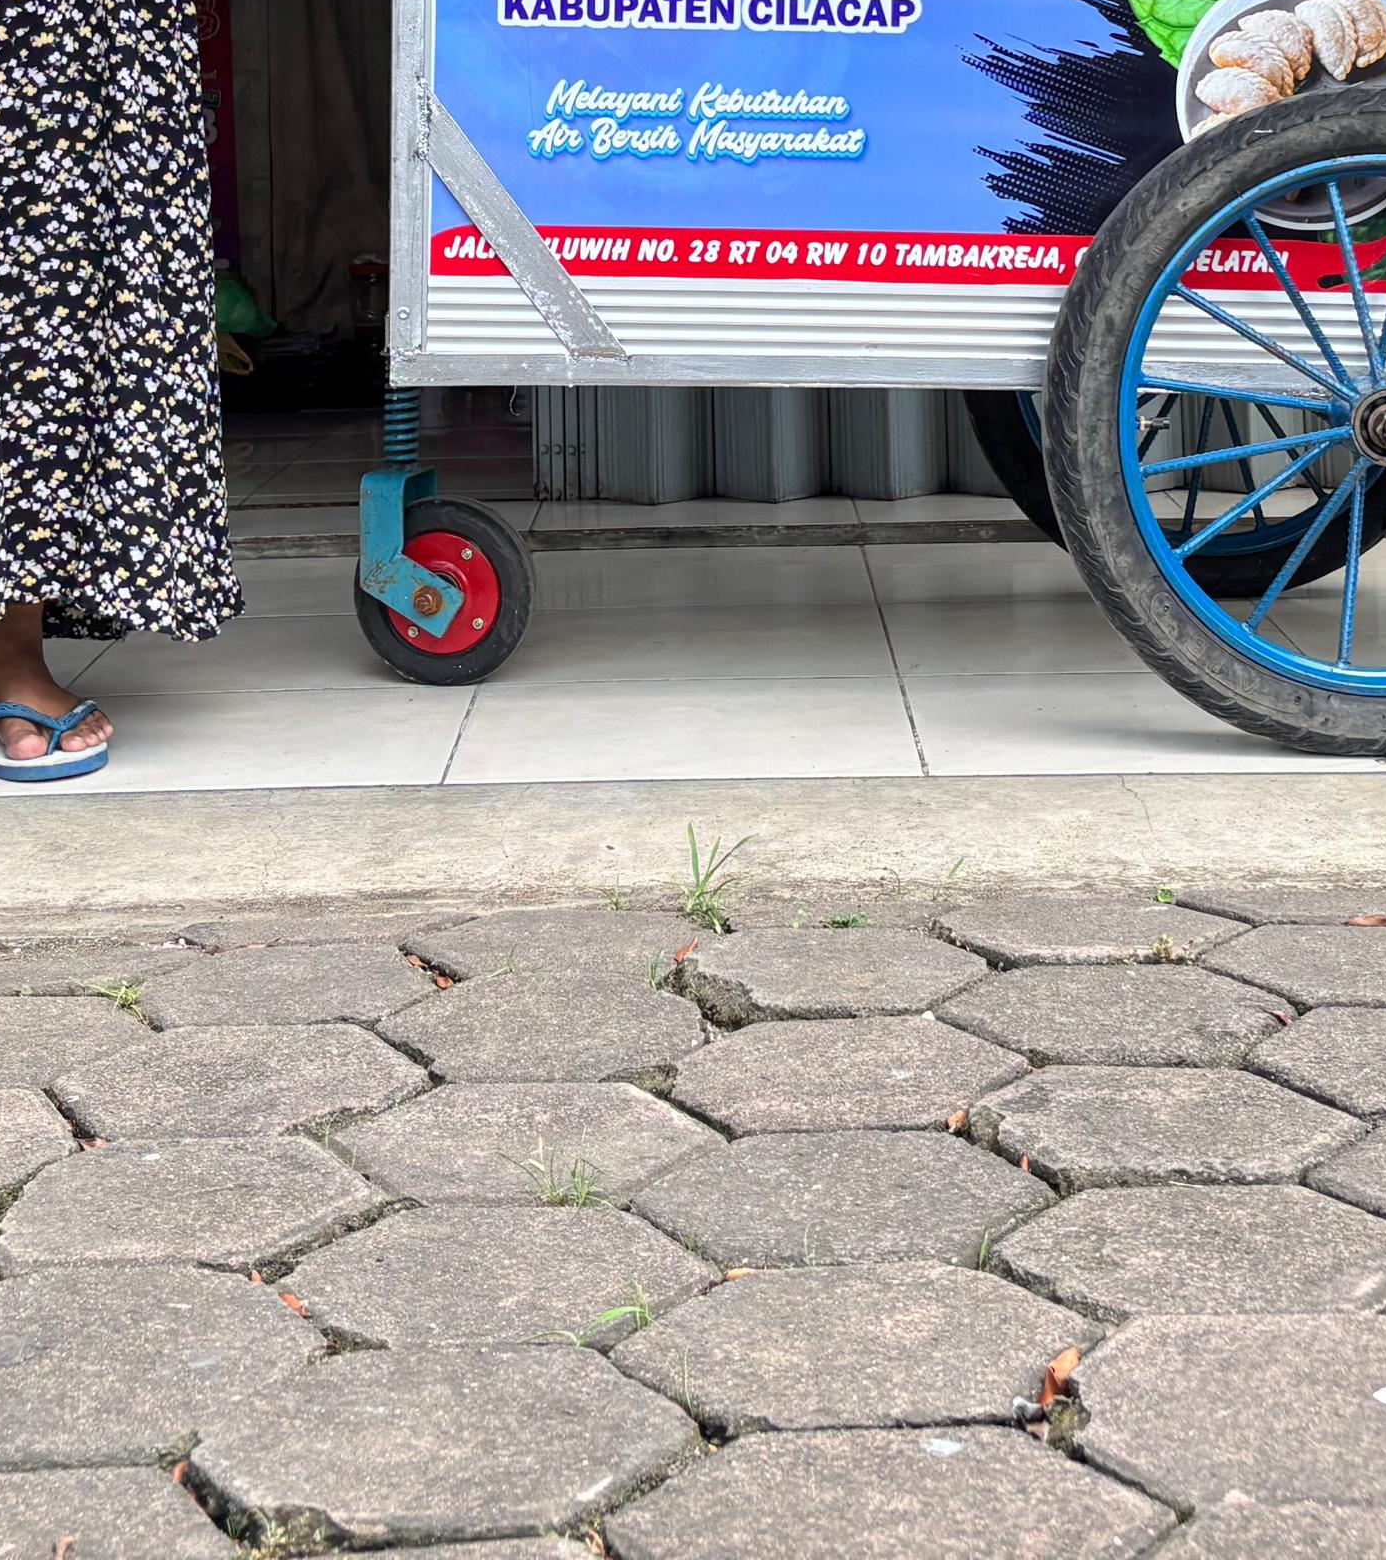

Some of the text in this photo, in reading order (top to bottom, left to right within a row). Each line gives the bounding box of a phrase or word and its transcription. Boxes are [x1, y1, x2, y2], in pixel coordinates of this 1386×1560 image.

[544, 79, 850, 124] Melayani Kebutuhan
[527, 117, 866, 164] Air Bersih Masyarakat
[637, 238, 679, 263] NO.
[688, 240, 721, 264] 28
[728, 240, 761, 265] RT
[766, 242, 799, 265] 04
[806, 242, 849, 266] RW
[858, 243, 887, 267] 10
[895, 243, 1067, 274] TAMBAKREJA,
